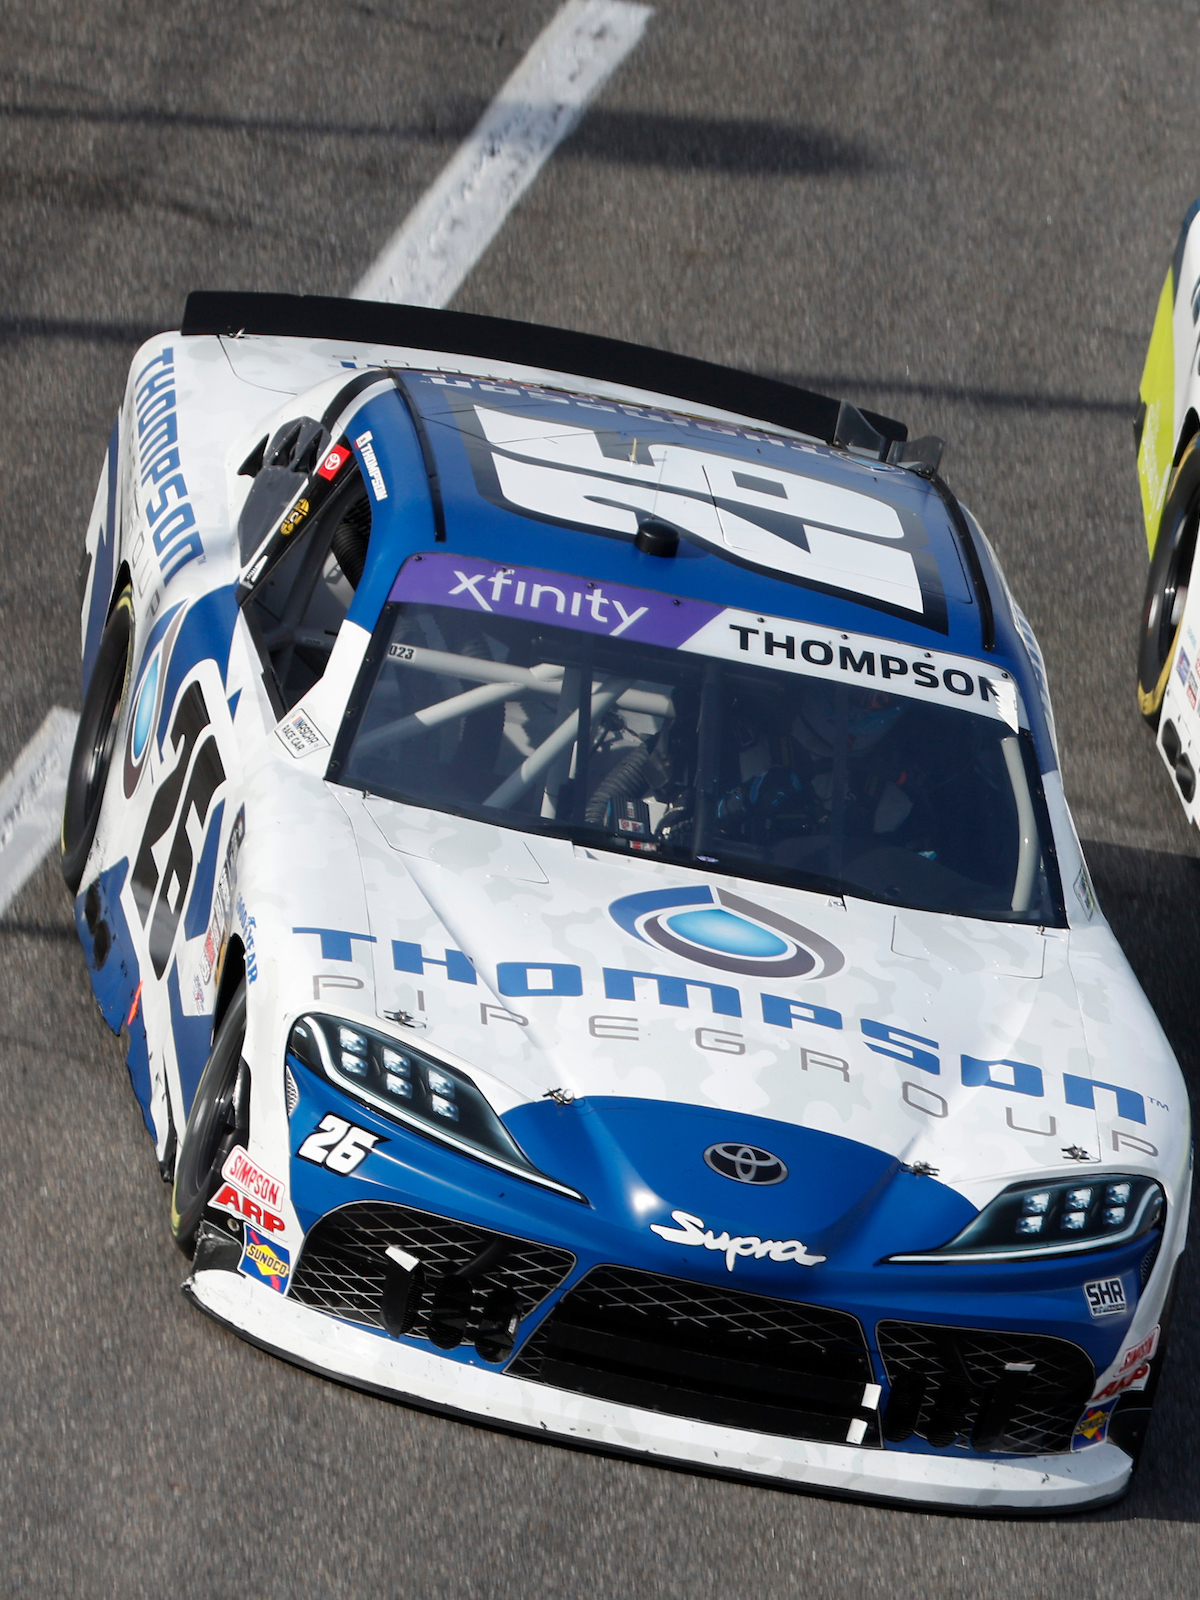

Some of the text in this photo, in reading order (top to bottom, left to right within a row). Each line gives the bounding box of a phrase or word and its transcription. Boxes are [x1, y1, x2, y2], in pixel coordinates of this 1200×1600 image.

[134, 347, 205, 588] THOMPSON
[360, 443, 388, 501] THOMPSON
[472, 403, 925, 614] 26
[448, 566, 650, 637] xfinity
[290, 737, 305, 751] CAR
[296, 721, 319, 745] NASCAR
[130, 680, 227, 981] 26
[292, 927, 1146, 1126] THOMPSON
[297, 1112, 385, 1176] 26
[215, 1185, 286, 1233] ARP
[229, 1155, 282, 1206] SIMPSON
[248, 1245, 289, 1276] SUNOCO
[649, 1209, 827, 1272] Supra
[1085, 1279, 1124, 1306] SHR
